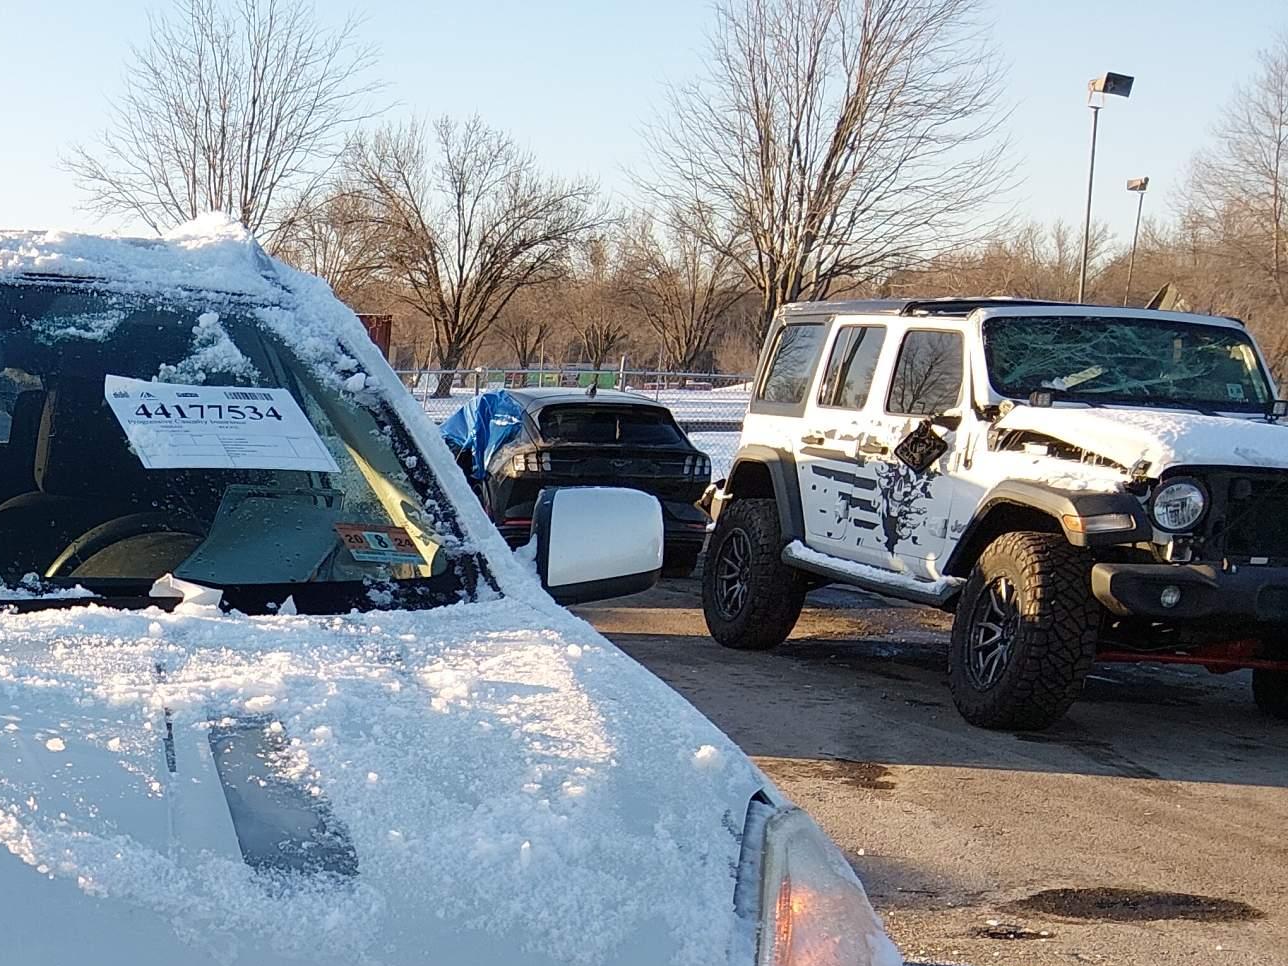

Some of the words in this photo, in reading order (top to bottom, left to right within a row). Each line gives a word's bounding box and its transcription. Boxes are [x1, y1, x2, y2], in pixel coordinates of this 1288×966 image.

[136, 402, 283, 421] 44177534
[345, 534, 364, 544] 20
[374, 534, 389, 548] 8
[394, 537, 414, 547] 24
